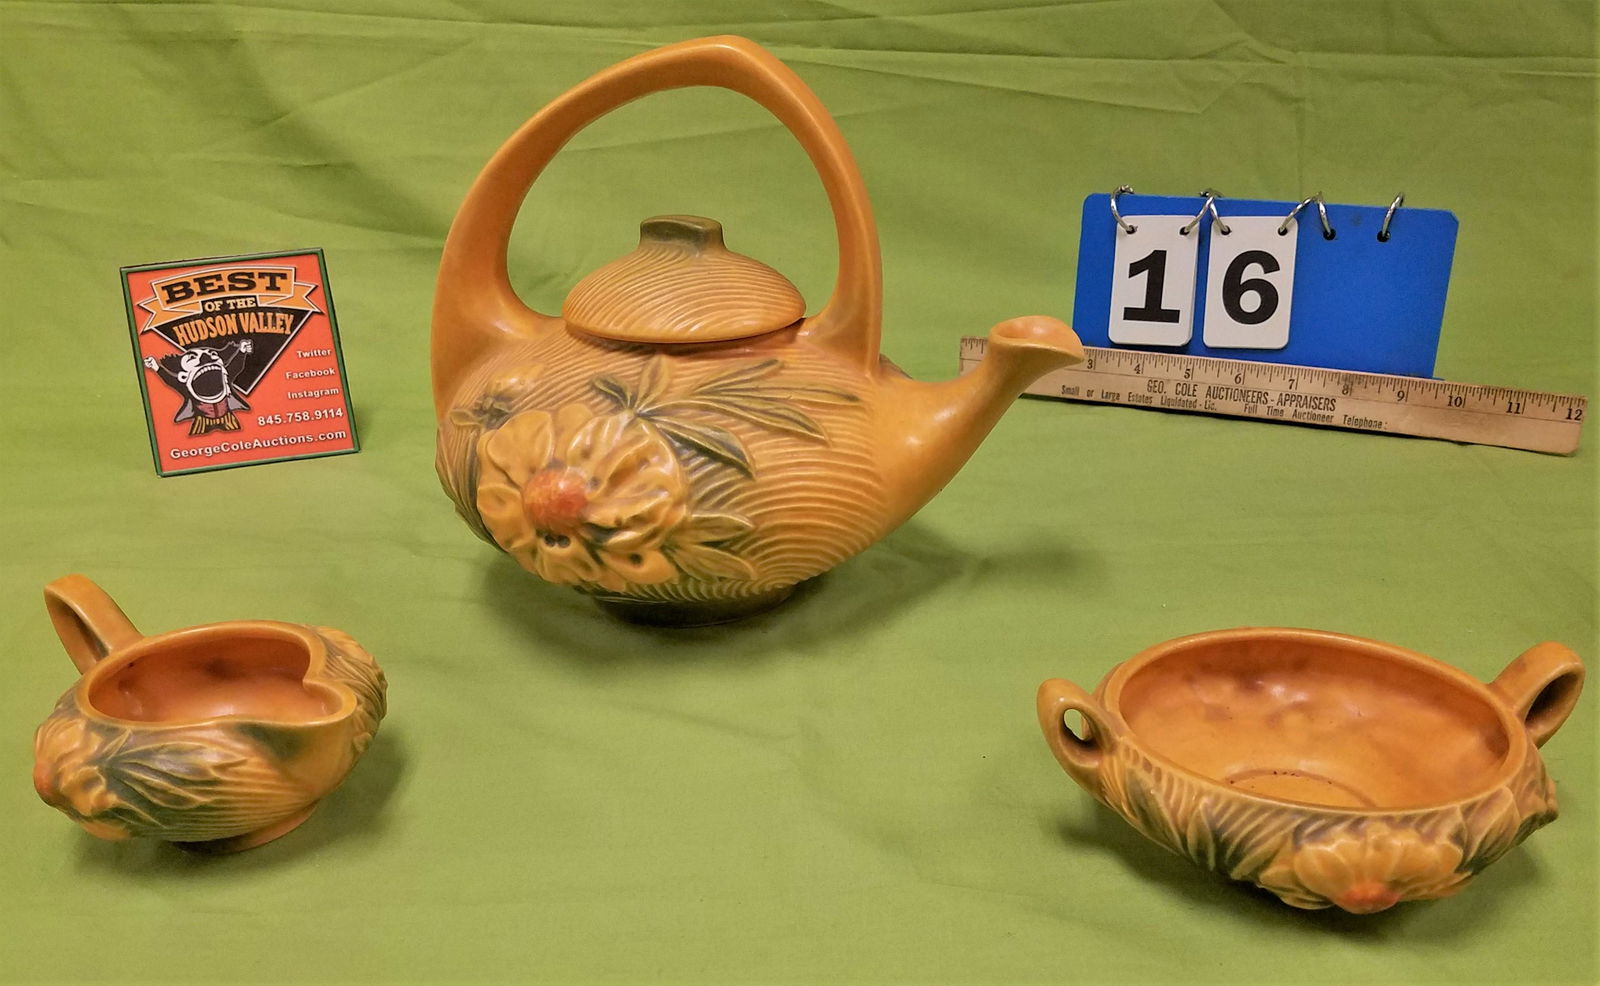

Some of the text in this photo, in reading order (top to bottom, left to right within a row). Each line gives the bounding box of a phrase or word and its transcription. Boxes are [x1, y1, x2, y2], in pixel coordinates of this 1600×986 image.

[160, 271, 288, 304] BEST
[204, 296, 257, 312] OF THE
[172, 312, 295, 347] HUDSON VALLEY
[296, 347, 332, 359] Twitter
[285, 367, 336, 380] Facebook
[287, 387, 340, 400] Instagram
[1061, 384, 1080, 396] Small
[1086, 389, 1094, 398] or
[1101, 389, 1121, 402] Large
[1127, 391, 1153, 405] Estates
[1160, 395, 1198, 409] Liquidated
[1087, 358, 1583, 421] 3 4 5 6 7 8 9 10 11 12
[1147, 380, 1167, 394] GEO.
[1175, 382, 1198, 397] COLE
[1205, 385, 1269, 405] AUCTIONEERS
[1276, 392, 1337, 412] APPRAISERS
[257, 408, 343, 426] 845.758.9114
[1243, 403, 1258, 414] Full
[1266, 405, 1285, 417] Time
[1291, 408, 1335, 423] Auctioneer
[170, 430, 347, 459] GeorgeColeAuctions.com
